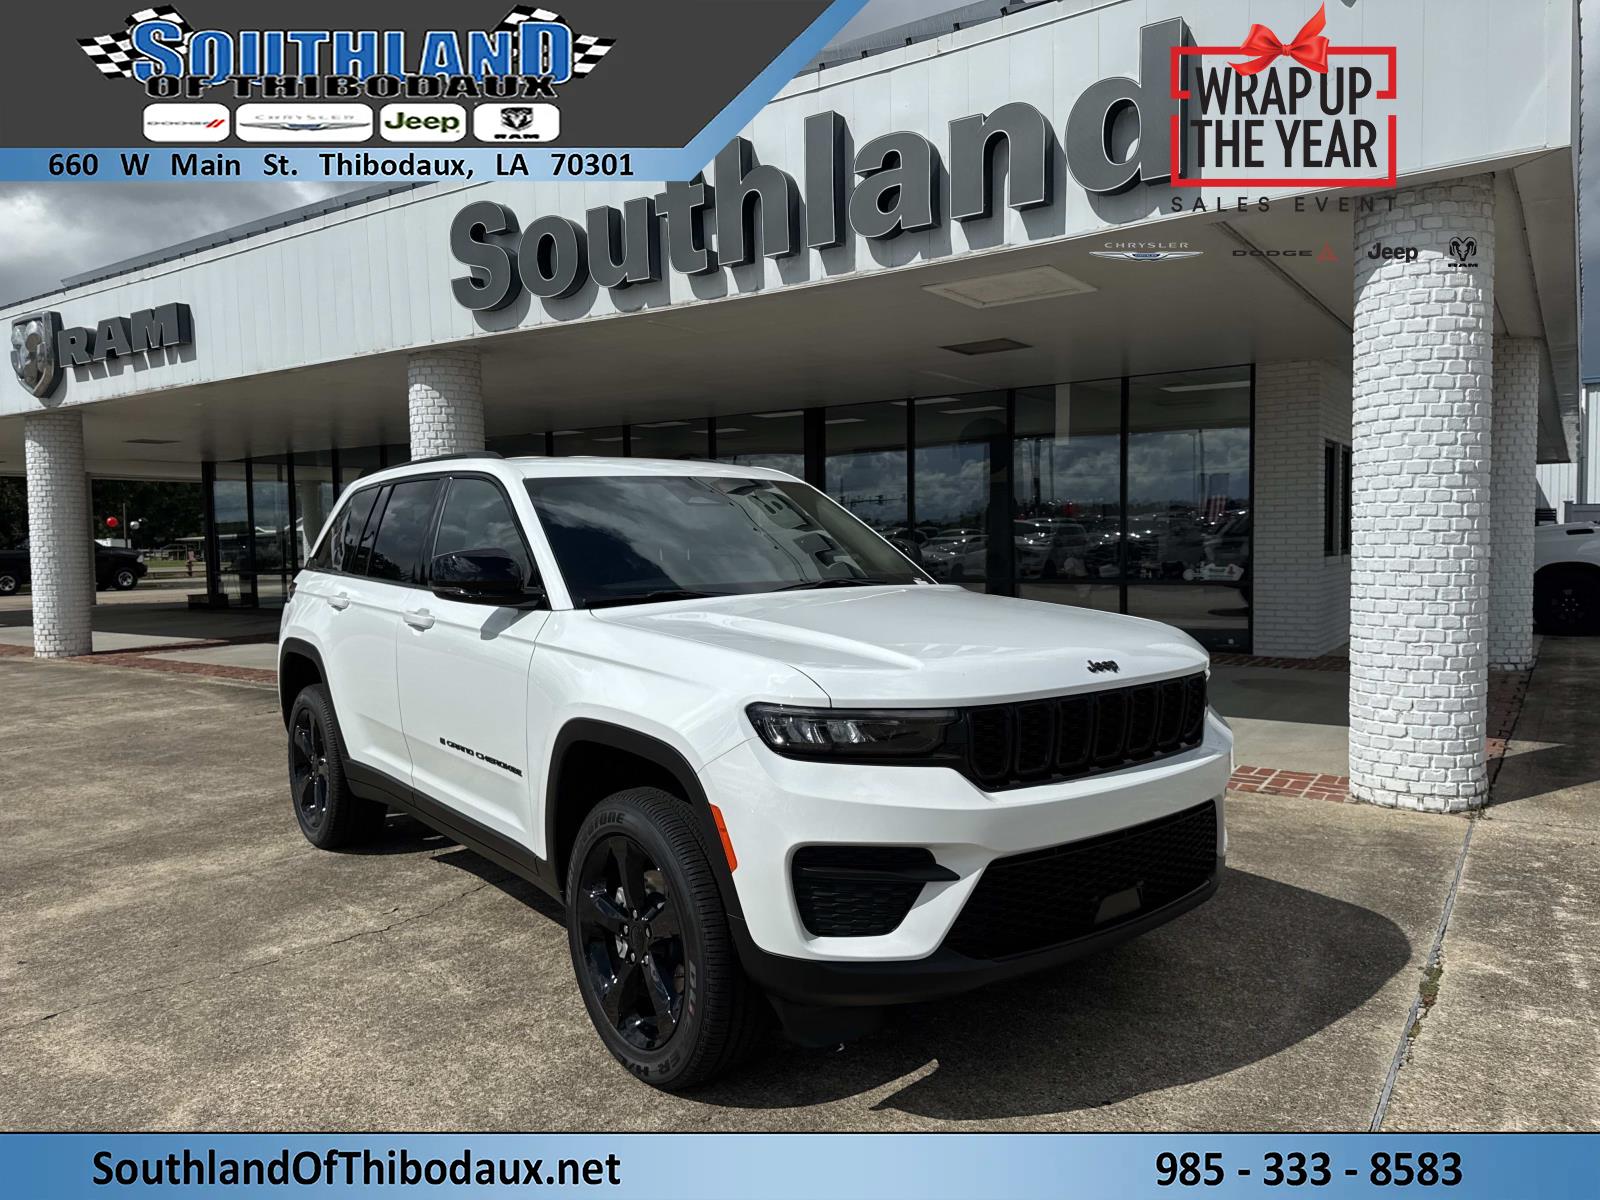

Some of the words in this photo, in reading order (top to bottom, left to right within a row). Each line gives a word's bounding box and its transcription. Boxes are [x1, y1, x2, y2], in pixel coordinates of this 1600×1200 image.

[450, 17, 1186, 311] Southland
[57, 302, 190, 368] RAM
[1087, 659, 1119, 674] Jeep
